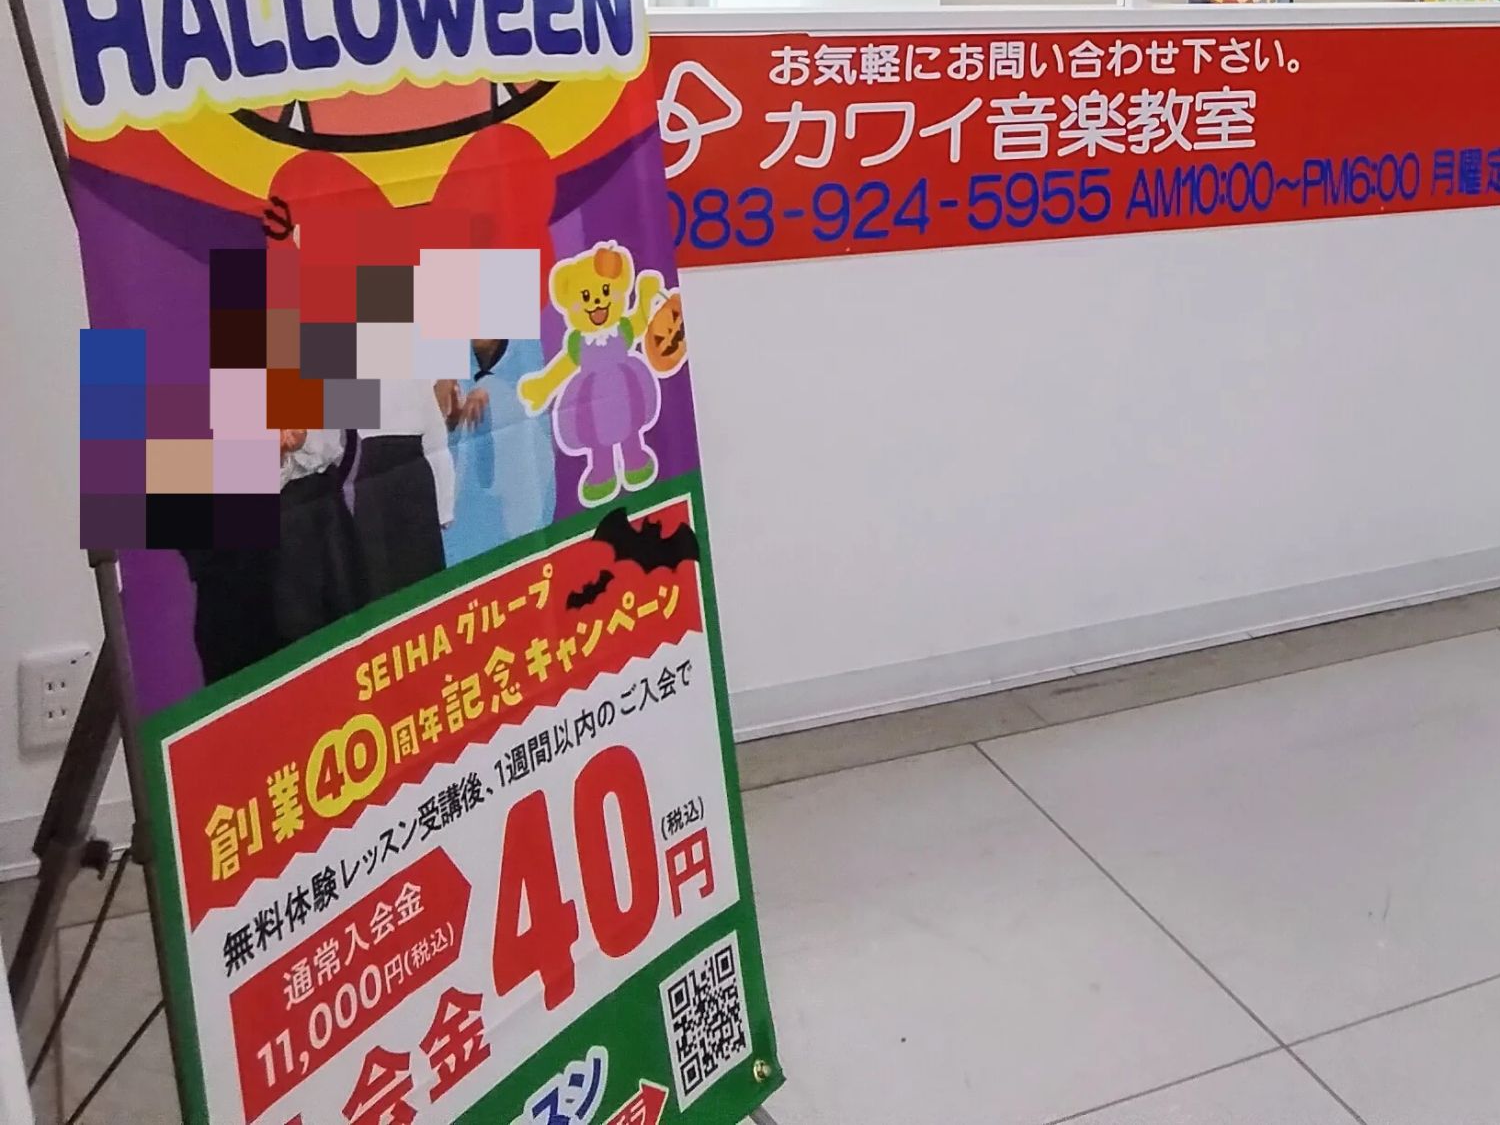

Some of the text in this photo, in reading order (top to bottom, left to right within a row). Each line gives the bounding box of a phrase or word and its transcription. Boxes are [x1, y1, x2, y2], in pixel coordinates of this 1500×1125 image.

[769, 37, 1300, 86] お気軽にお問い合わせ下さい。
[760, 85, 1257, 171] カワイ音楽教室
[356, 563, 553, 701] SEIHA グループ
[283, 881, 425, 1011] 通常入会金
[283, 986, 491, 1125] 会金
